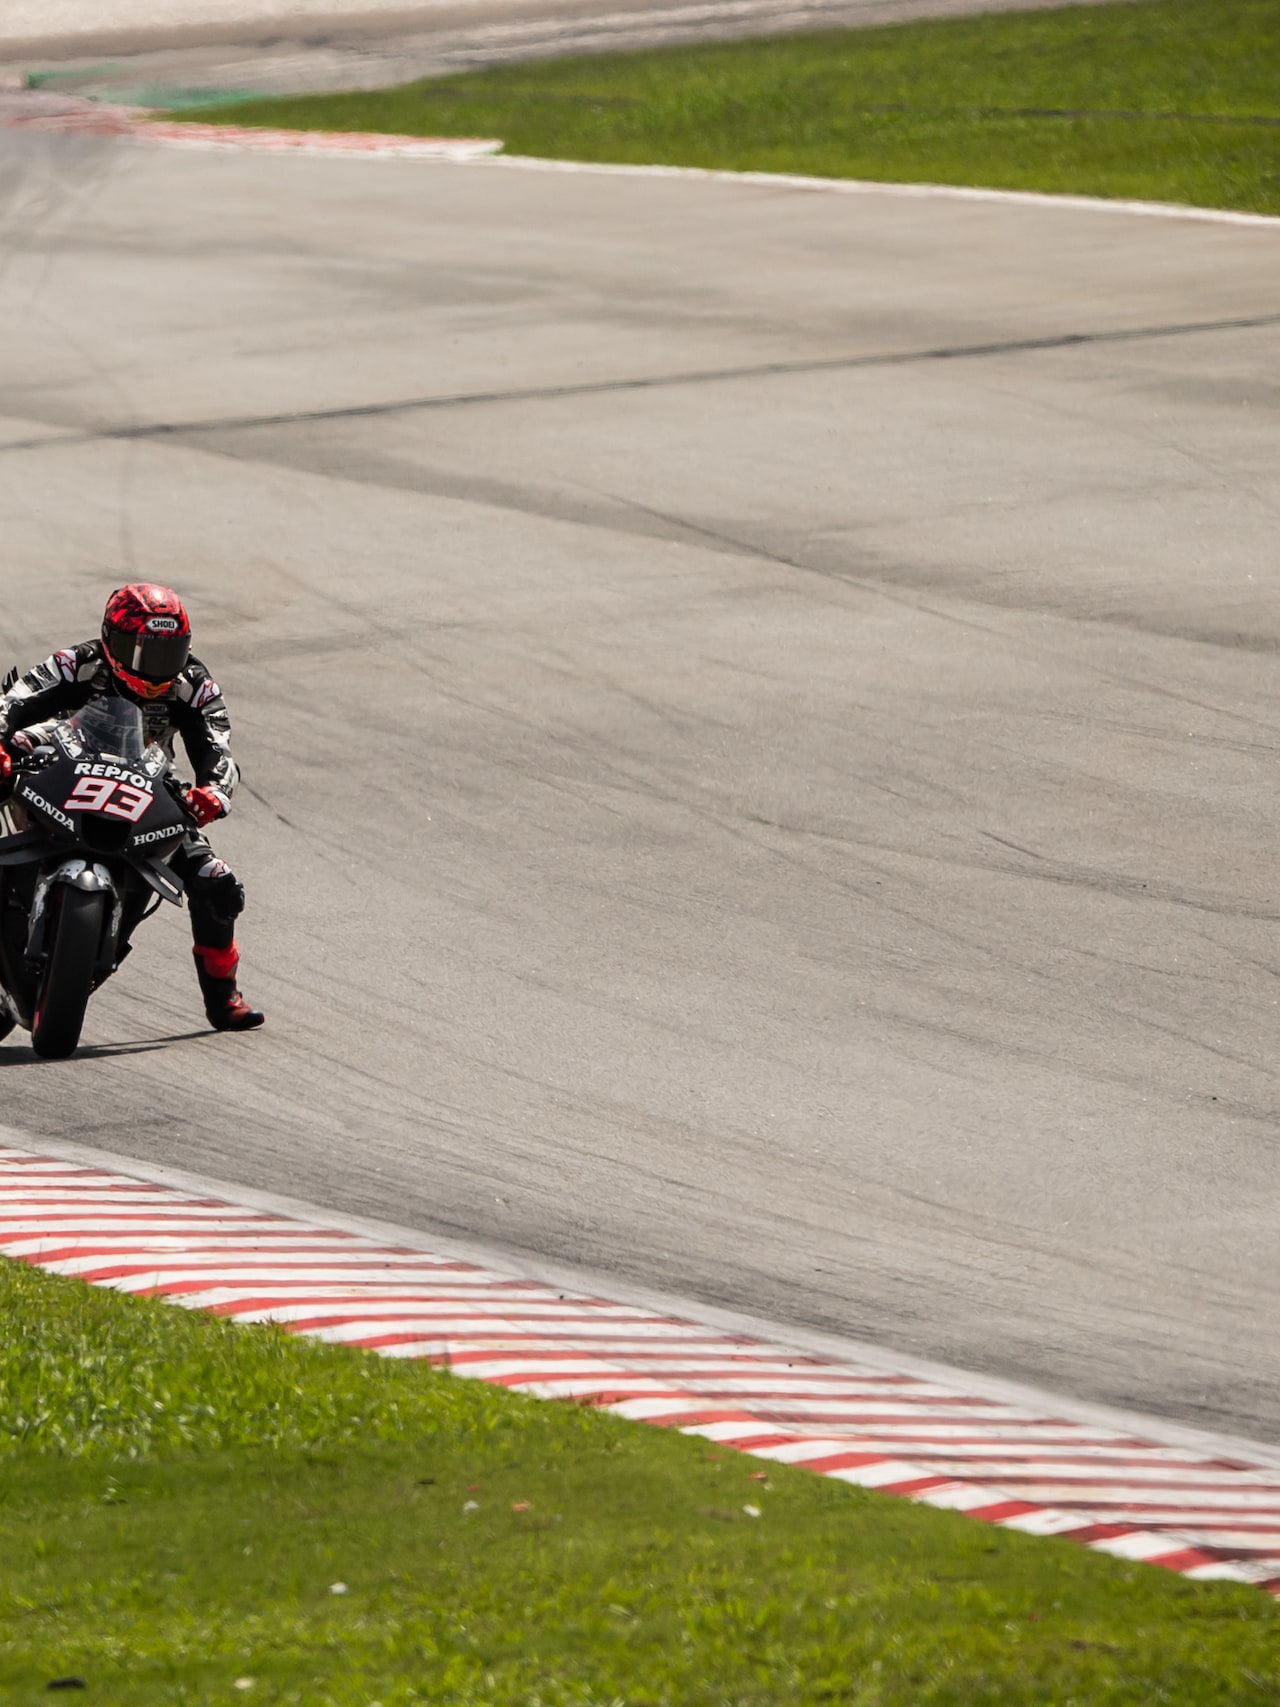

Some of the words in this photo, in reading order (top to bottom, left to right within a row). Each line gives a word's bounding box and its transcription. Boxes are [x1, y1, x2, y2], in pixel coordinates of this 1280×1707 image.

[151, 620, 175, 629] SHOEI
[74, 762, 154, 794] REPSOL
[21, 786, 75, 832] HONDA
[64, 776, 154, 823] 93
[133, 824, 184, 846] HONDA
